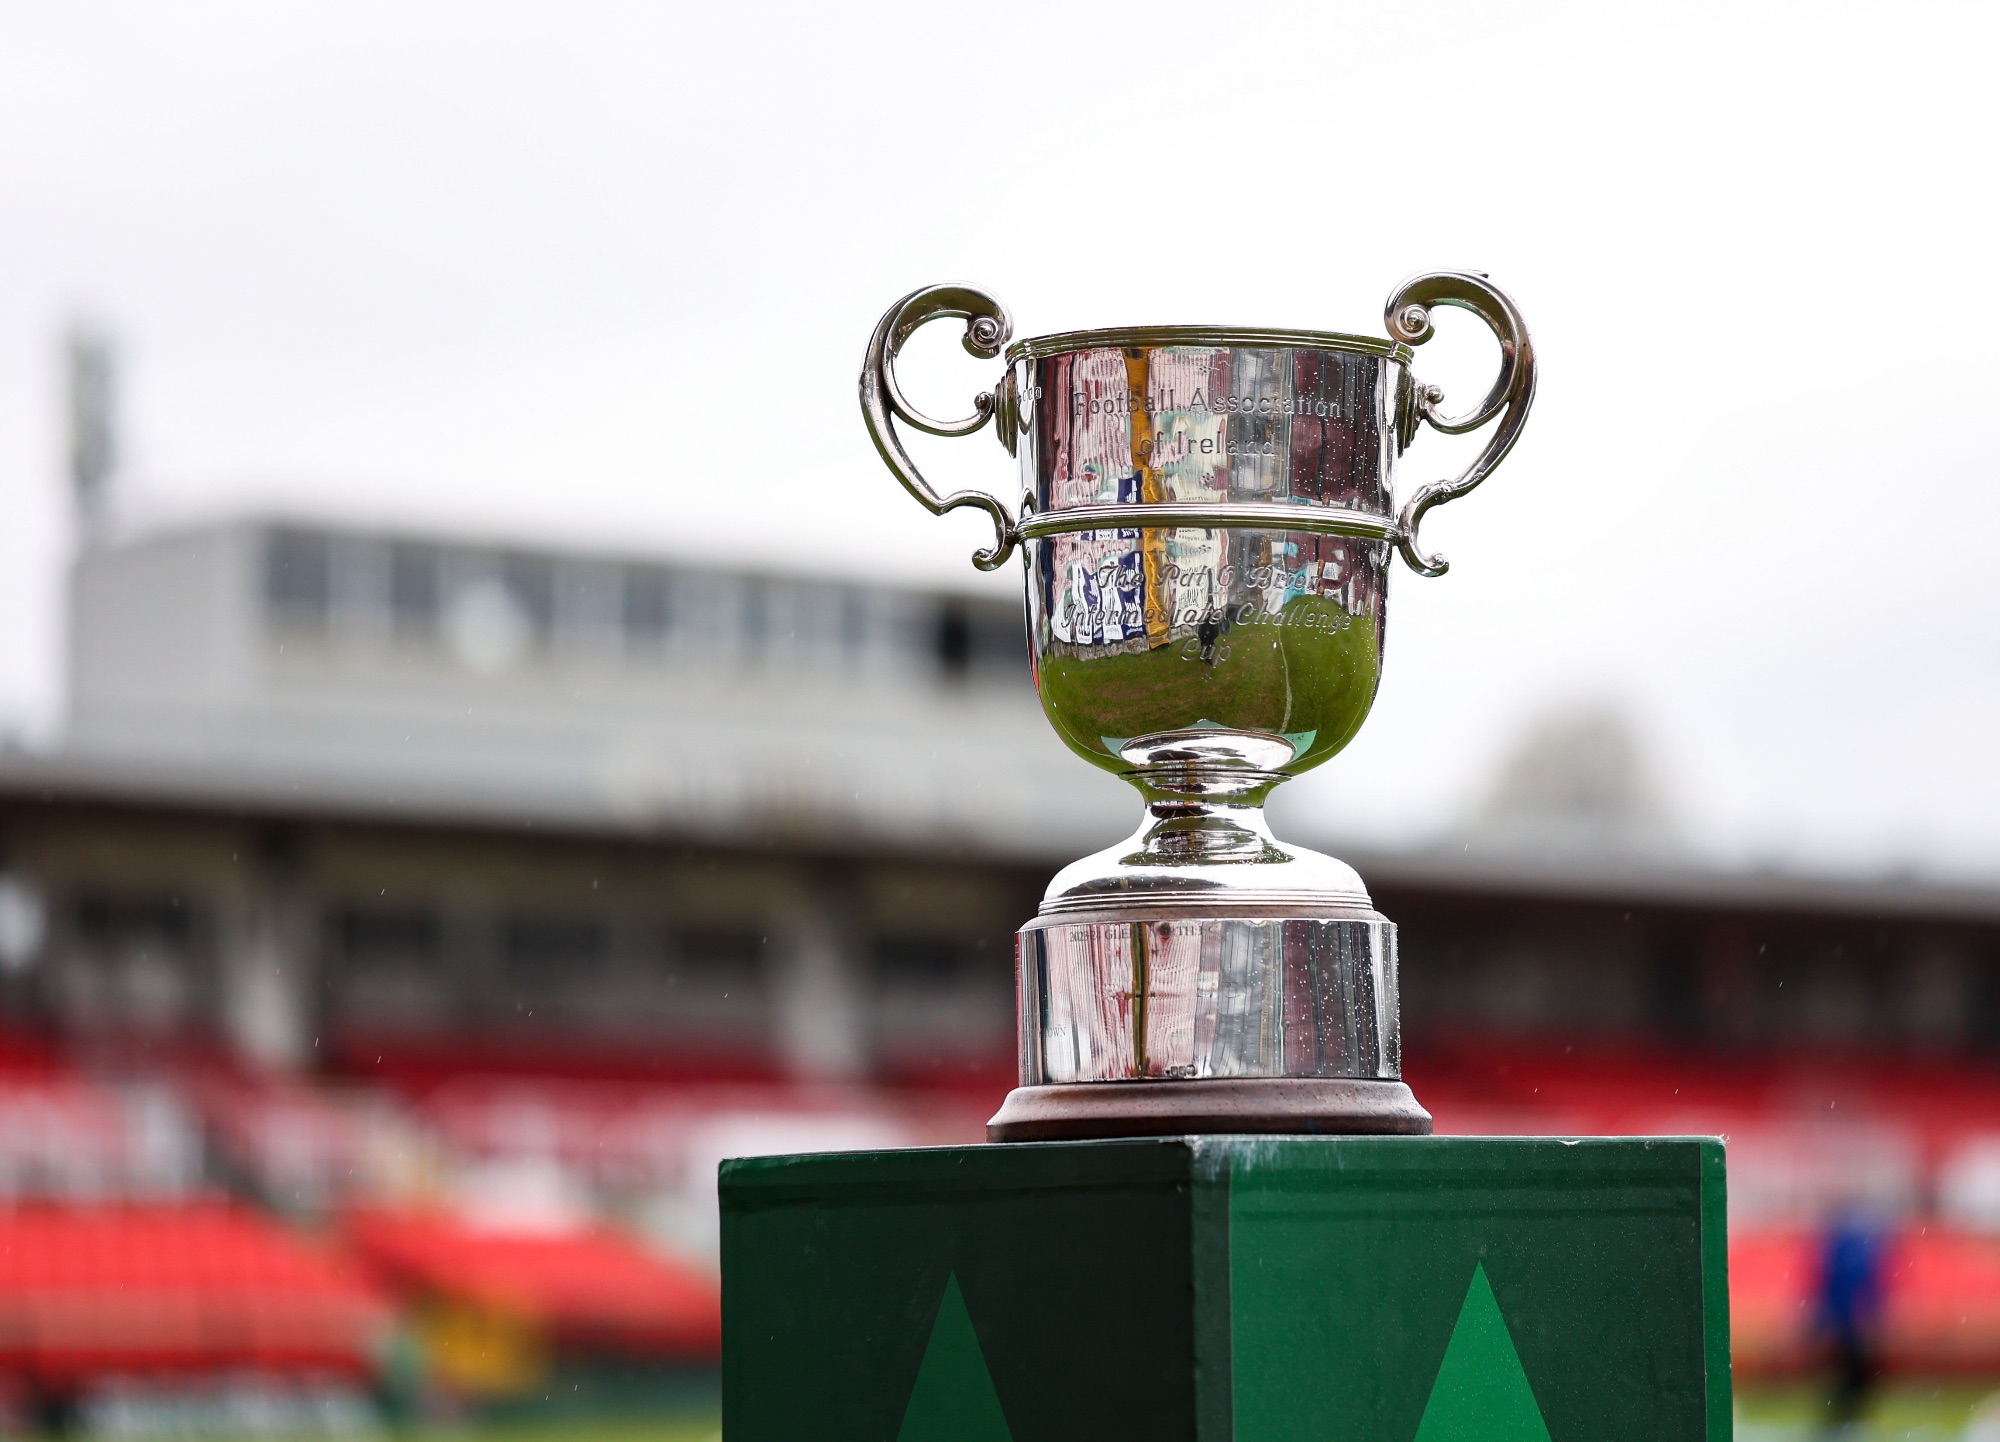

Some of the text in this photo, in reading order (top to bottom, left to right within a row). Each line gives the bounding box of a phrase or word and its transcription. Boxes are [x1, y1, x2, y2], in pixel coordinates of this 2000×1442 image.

[1074, 387, 1342, 418] Football Association
[1139, 431, 1277, 457] of Ireland
[1098, 565, 1144, 588] The
[1153, 564, 1212, 588] Pat
[1061, 603, 1225, 629] Intermediate
[1235, 602, 1352, 635] Challenge
[1181, 637, 1231, 668] Cup
